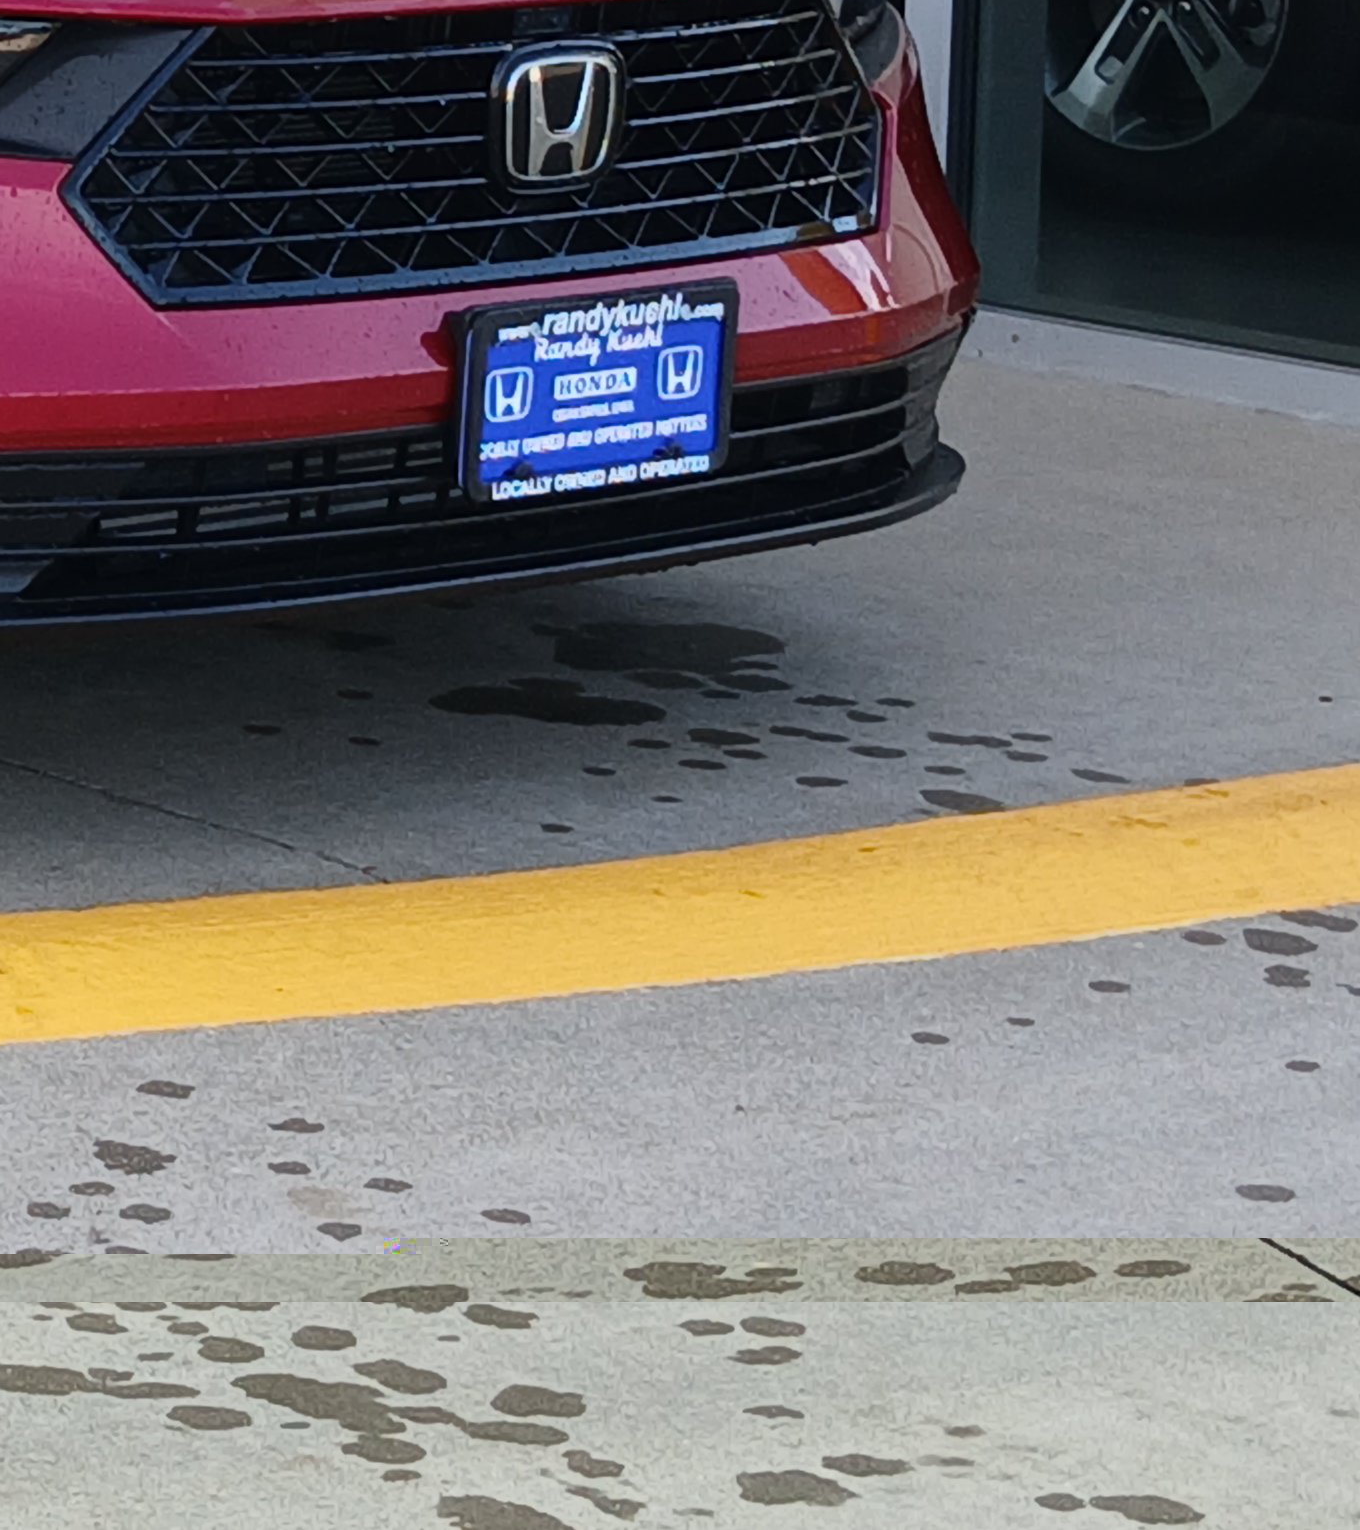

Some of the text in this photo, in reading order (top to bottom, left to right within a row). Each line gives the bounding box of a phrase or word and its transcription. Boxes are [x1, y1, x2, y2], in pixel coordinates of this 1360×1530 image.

[534, 323, 663, 367] Randy Kuehl
[559, 371, 632, 395] HONDA
[492, 476, 552, 501] LOCALLY
